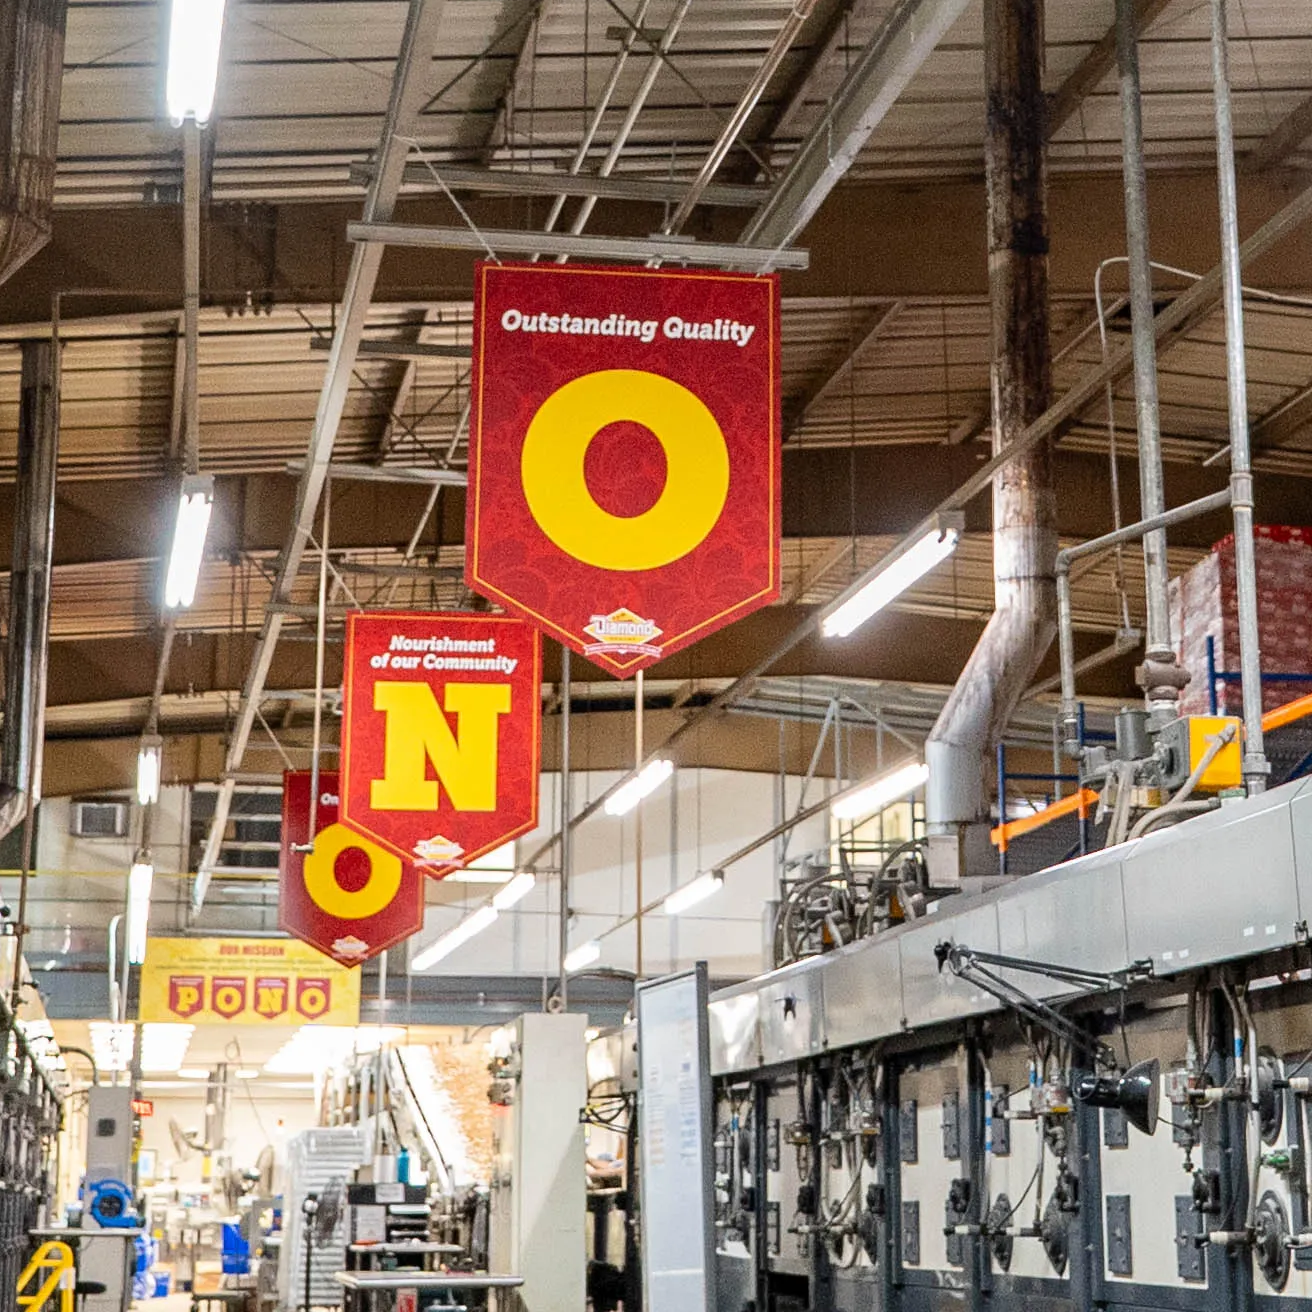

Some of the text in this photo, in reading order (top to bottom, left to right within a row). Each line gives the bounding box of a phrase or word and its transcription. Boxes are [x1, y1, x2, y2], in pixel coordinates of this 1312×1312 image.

[501, 309, 756, 348] Outstanding Quality
[520, 369, 730, 571] O
[370, 652, 518, 675] of our Community
[389, 635, 496, 653] Nourishment
[370, 680, 512, 812] N
[303, 822, 403, 920] O
